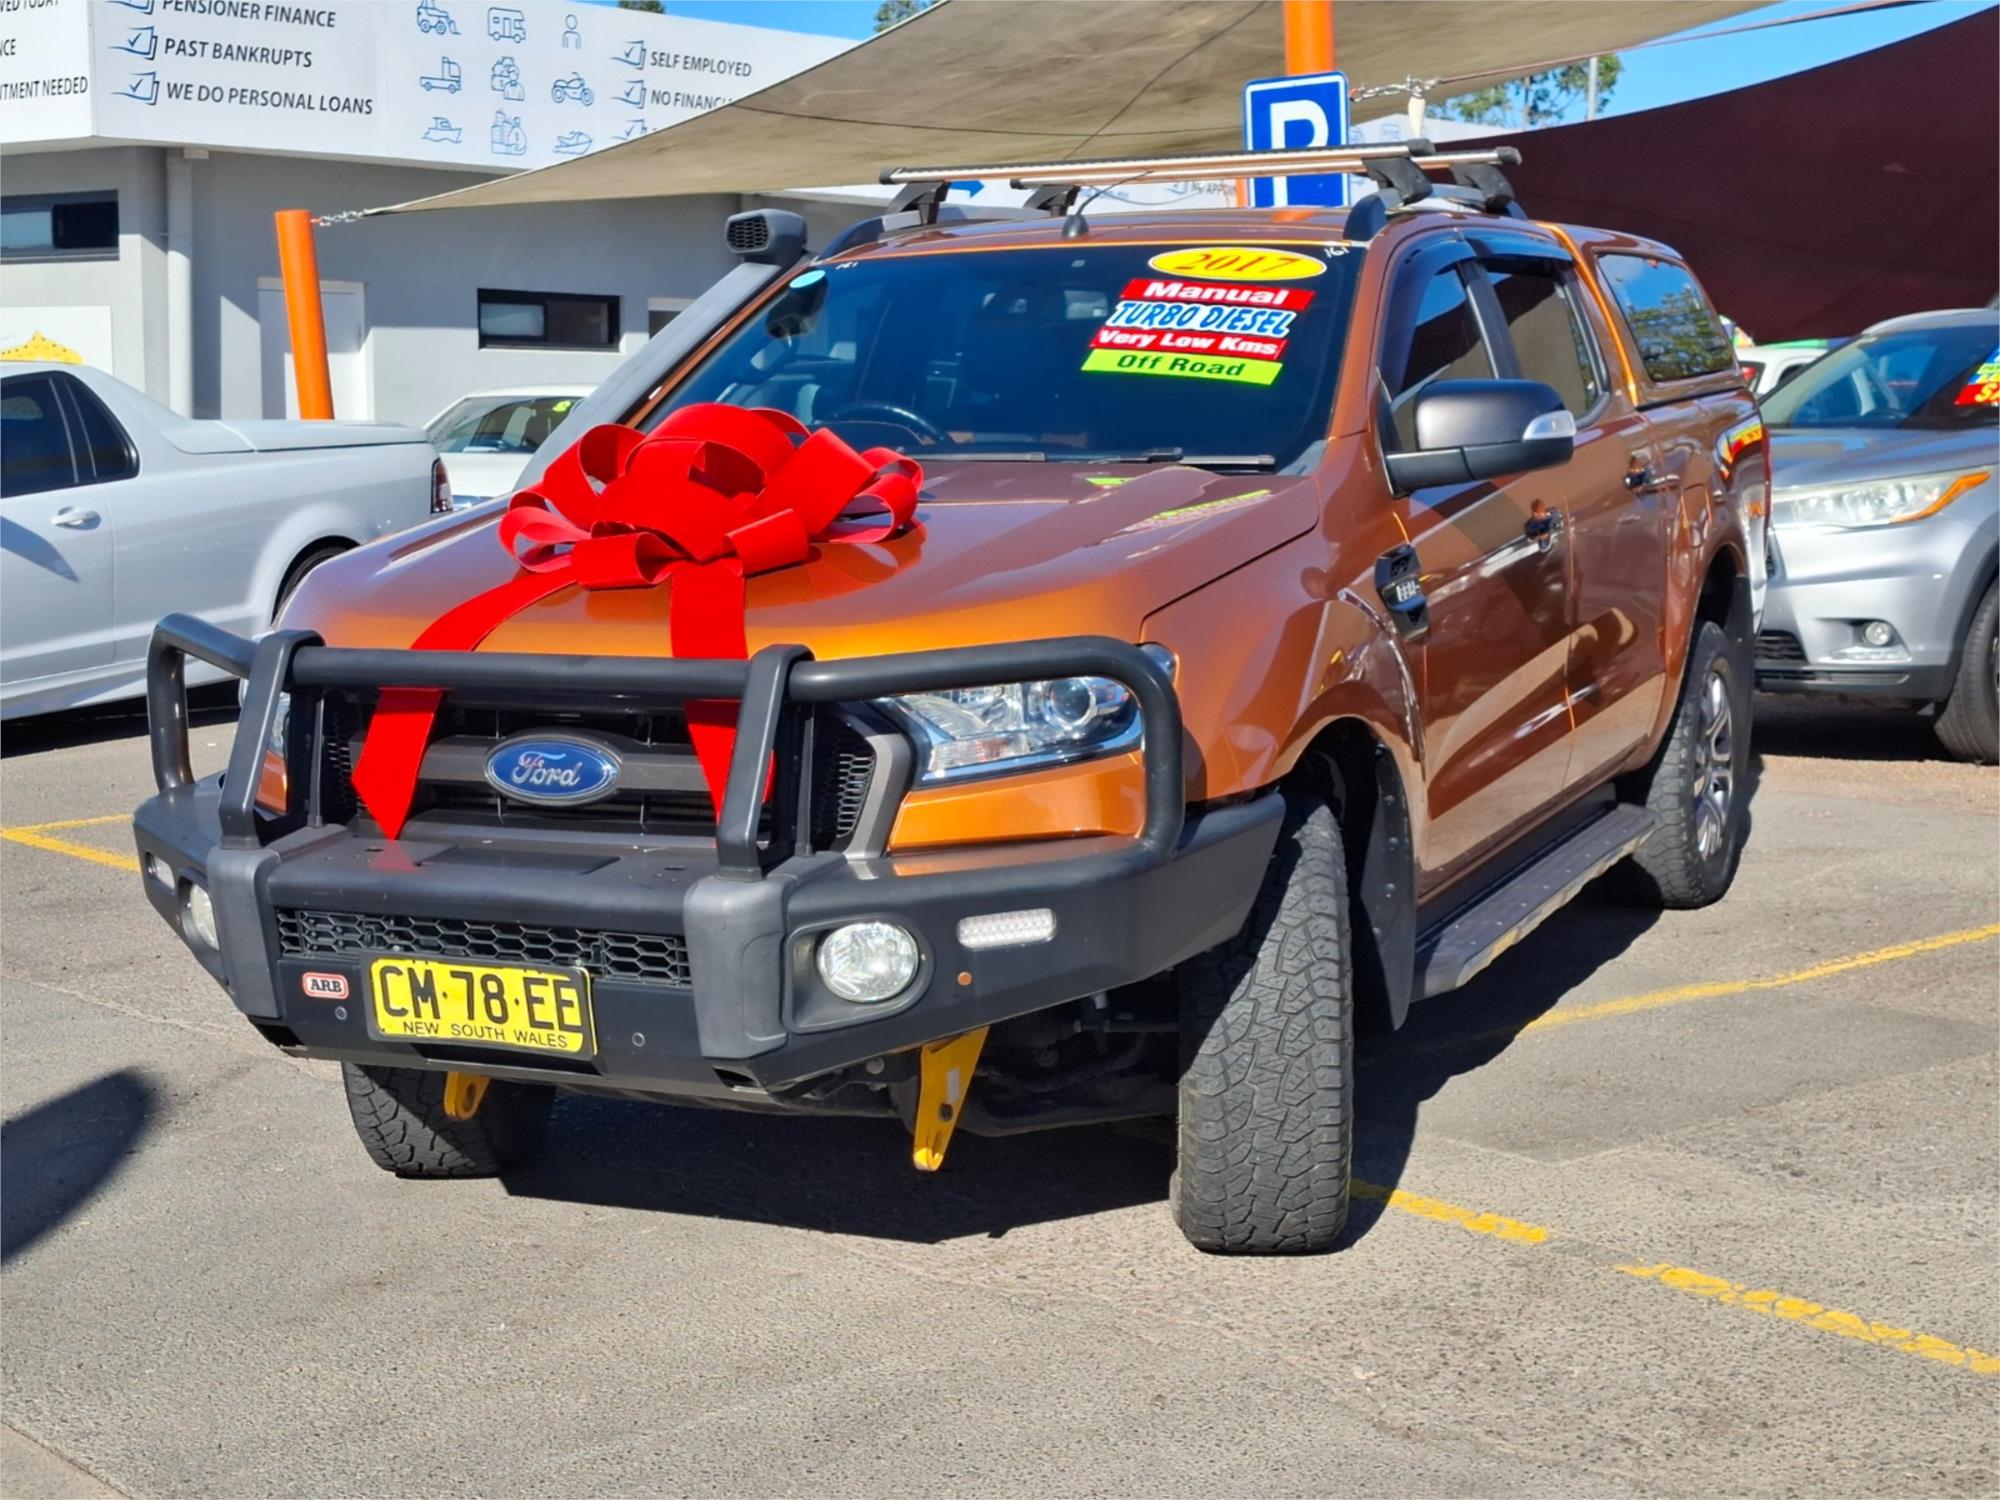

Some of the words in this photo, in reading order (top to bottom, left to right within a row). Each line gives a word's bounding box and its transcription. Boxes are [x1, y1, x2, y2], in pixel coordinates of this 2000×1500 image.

[162, 0, 260, 20] PENSIONER
[264, 4, 337, 28] FINANCE
[164, 38, 209, 57] PAST
[212, 42, 313, 68] BANKRUPTS
[650, 51, 681, 69] SELF
[682, 55, 752, 77] EMPLOYED
[43, 76, 88, 97] NEEDED
[166, 82, 195, 101] WE
[199, 85, 225, 103] DO
[228, 87, 315, 111] PERSONAL
[319, 95, 374, 115] LOANS
[651, 89, 671, 106] NO
[673, 92, 734, 109] FINANC
[1270, 99, 1329, 207] P
[1175, 253, 1298, 273] 2017
[1145, 282, 1289, 305] Manual
[1110, 302, 1200, 327] TURBO
[1201, 309, 1294, 336] DIESEL
[1099, 330, 1152, 350] Very
[1159, 332, 1214, 349] Low
[1218, 336, 1280, 355] Kms
[1116, 354, 1164, 370] Off
[1168, 358, 1246, 377] Road
[511, 750, 583, 787] Ford
[310, 977, 343, 993] ARB
[403, 1020, 440, 1035] NEW
[450, 1022, 506, 1041] SOUTH
[513, 1028, 569, 1049] WALES
